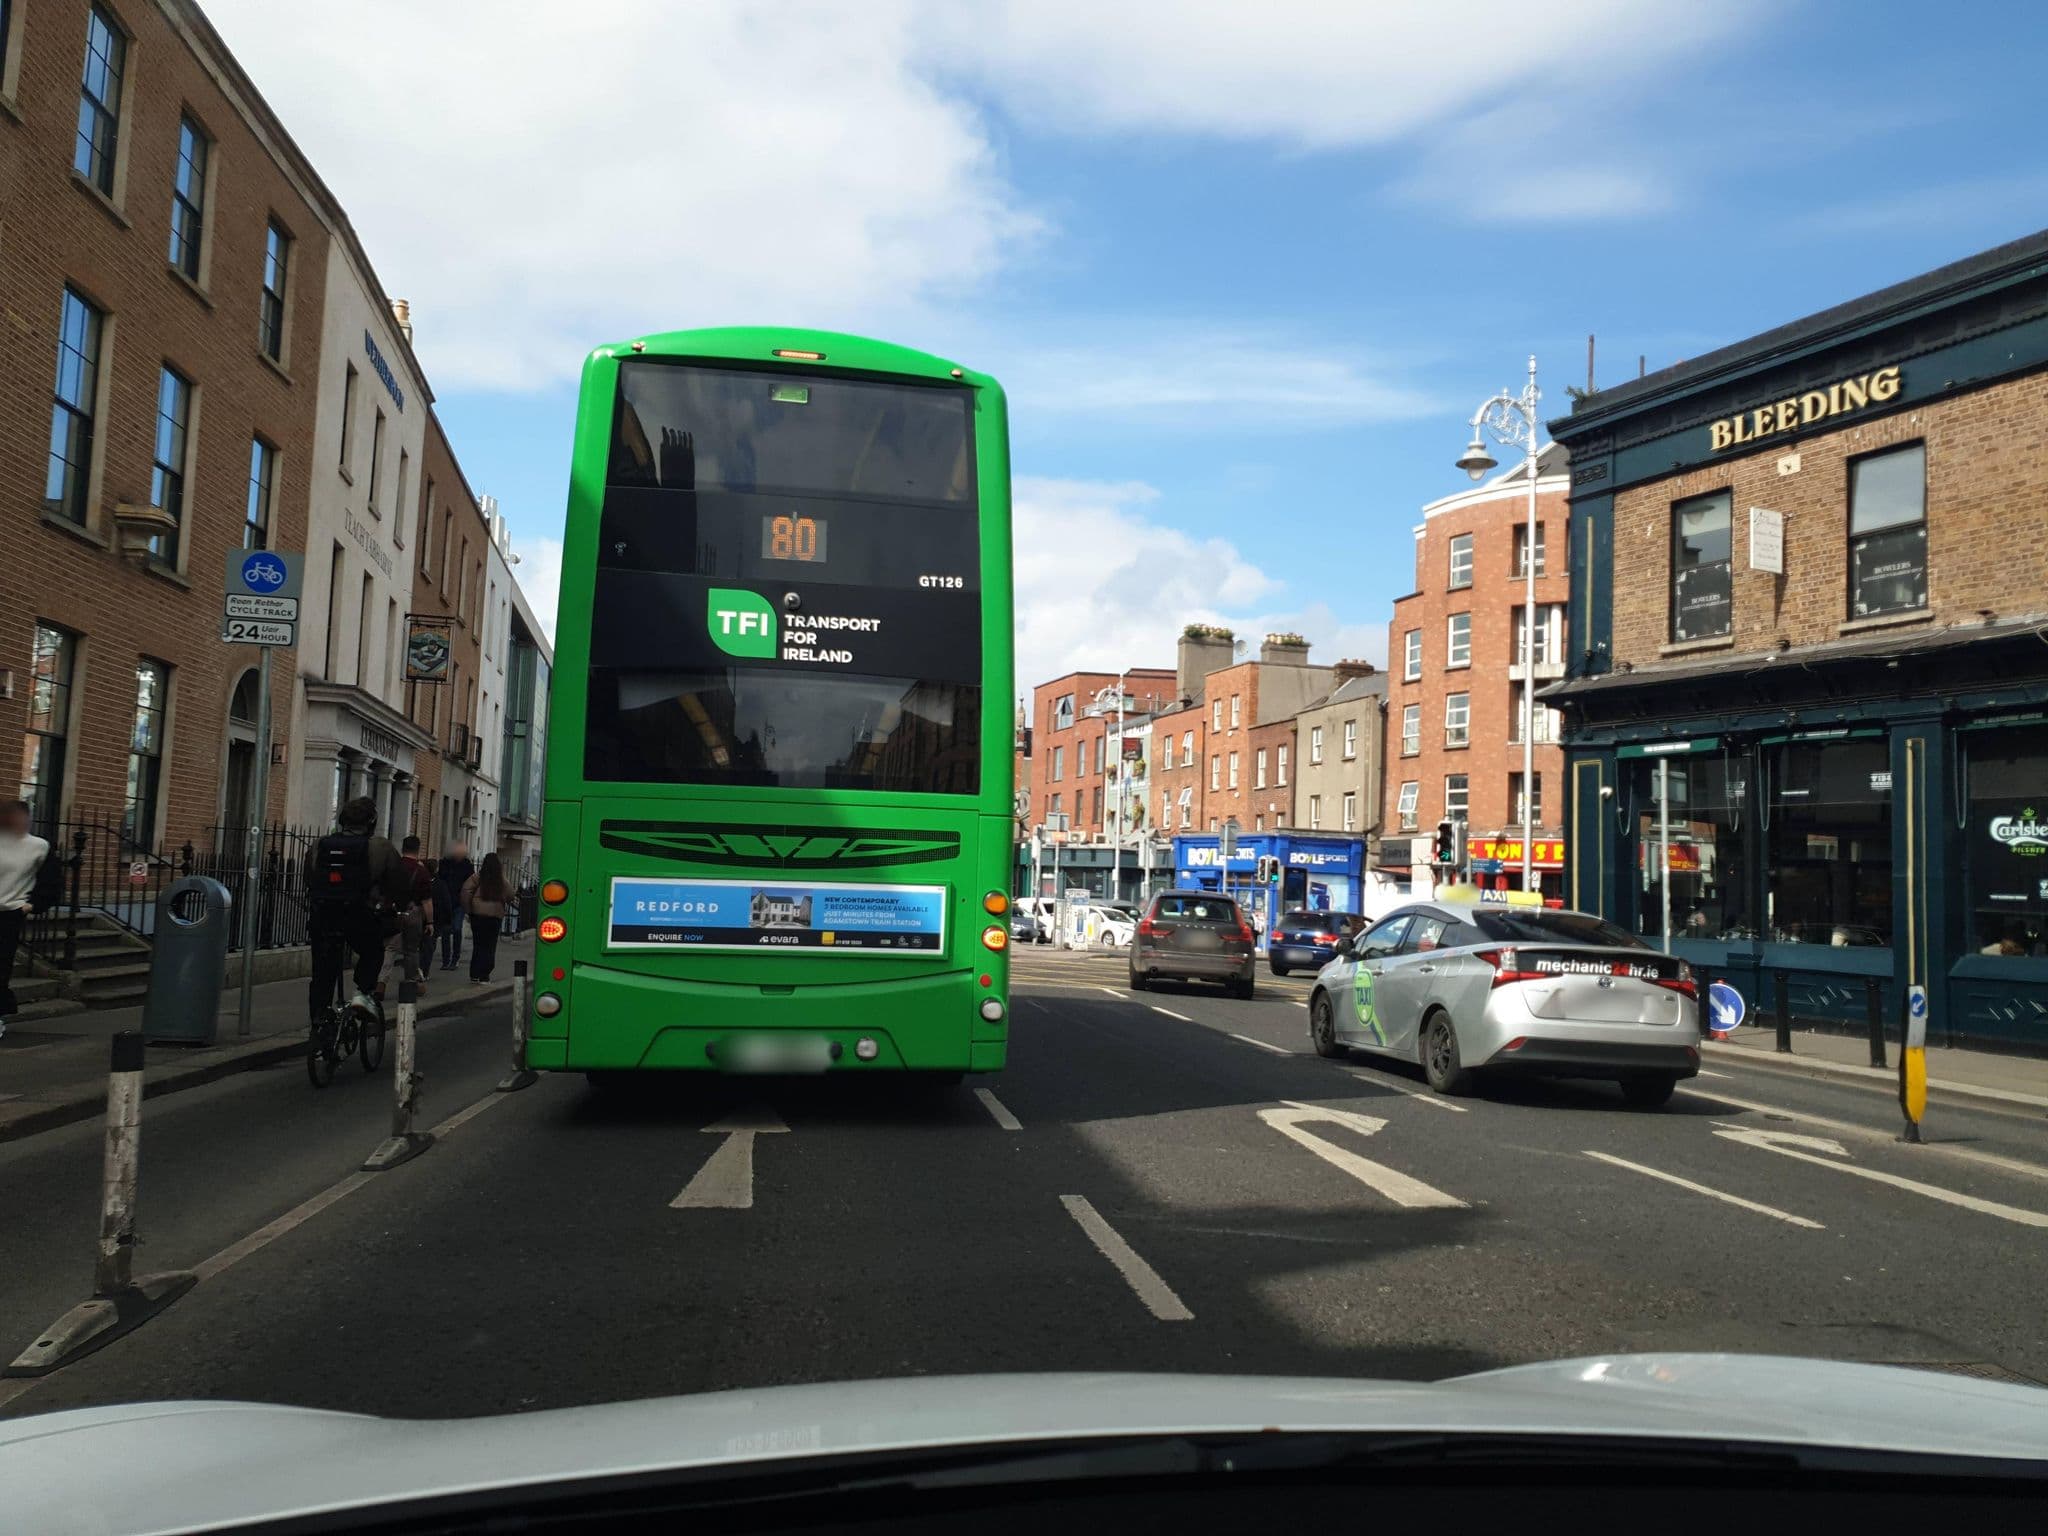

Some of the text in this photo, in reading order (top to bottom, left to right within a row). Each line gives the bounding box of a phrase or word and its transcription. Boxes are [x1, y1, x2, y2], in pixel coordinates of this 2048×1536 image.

[1709, 365, 1900, 451] BLEEDING
[772, 516, 816, 560] 80
[919, 575, 963, 589] GT126
[230, 606, 293, 617] CYCLE TRACK
[717, 610, 768, 636] TFI
[784, 614, 881, 632] TRANSPORT
[232, 624, 260, 640] 24
[260, 633, 288, 642] HOUR
[783, 631, 817, 645] FOR
[783, 648, 853, 664] IRELAND
[1485, 842, 1546, 860] TON'S
[1482, 890, 1507, 901] AXI
[636, 900, 719, 913] REDFORD
[648, 933, 683, 941] ENQUIRE
[770, 935, 799, 944] evara
